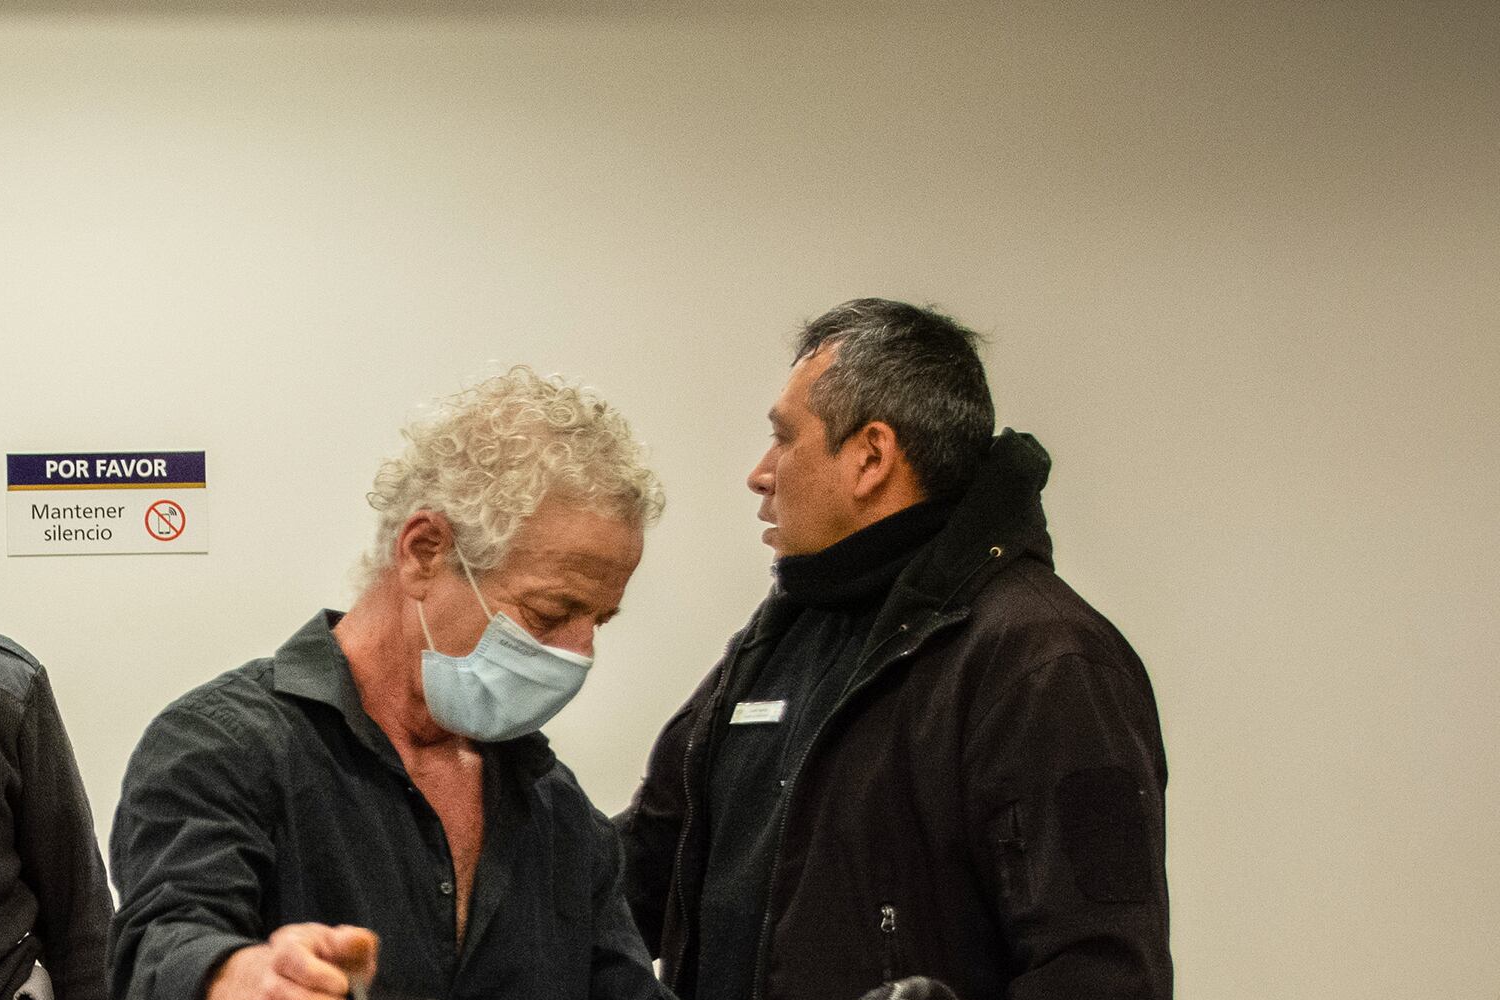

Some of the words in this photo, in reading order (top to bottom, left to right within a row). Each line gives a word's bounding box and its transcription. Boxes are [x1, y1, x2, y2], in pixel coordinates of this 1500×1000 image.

[45, 460, 89, 479] POR
[96, 459, 167, 478] FAVOR
[31, 504, 125, 520] Mantener
[44, 525, 112, 542] silencio
